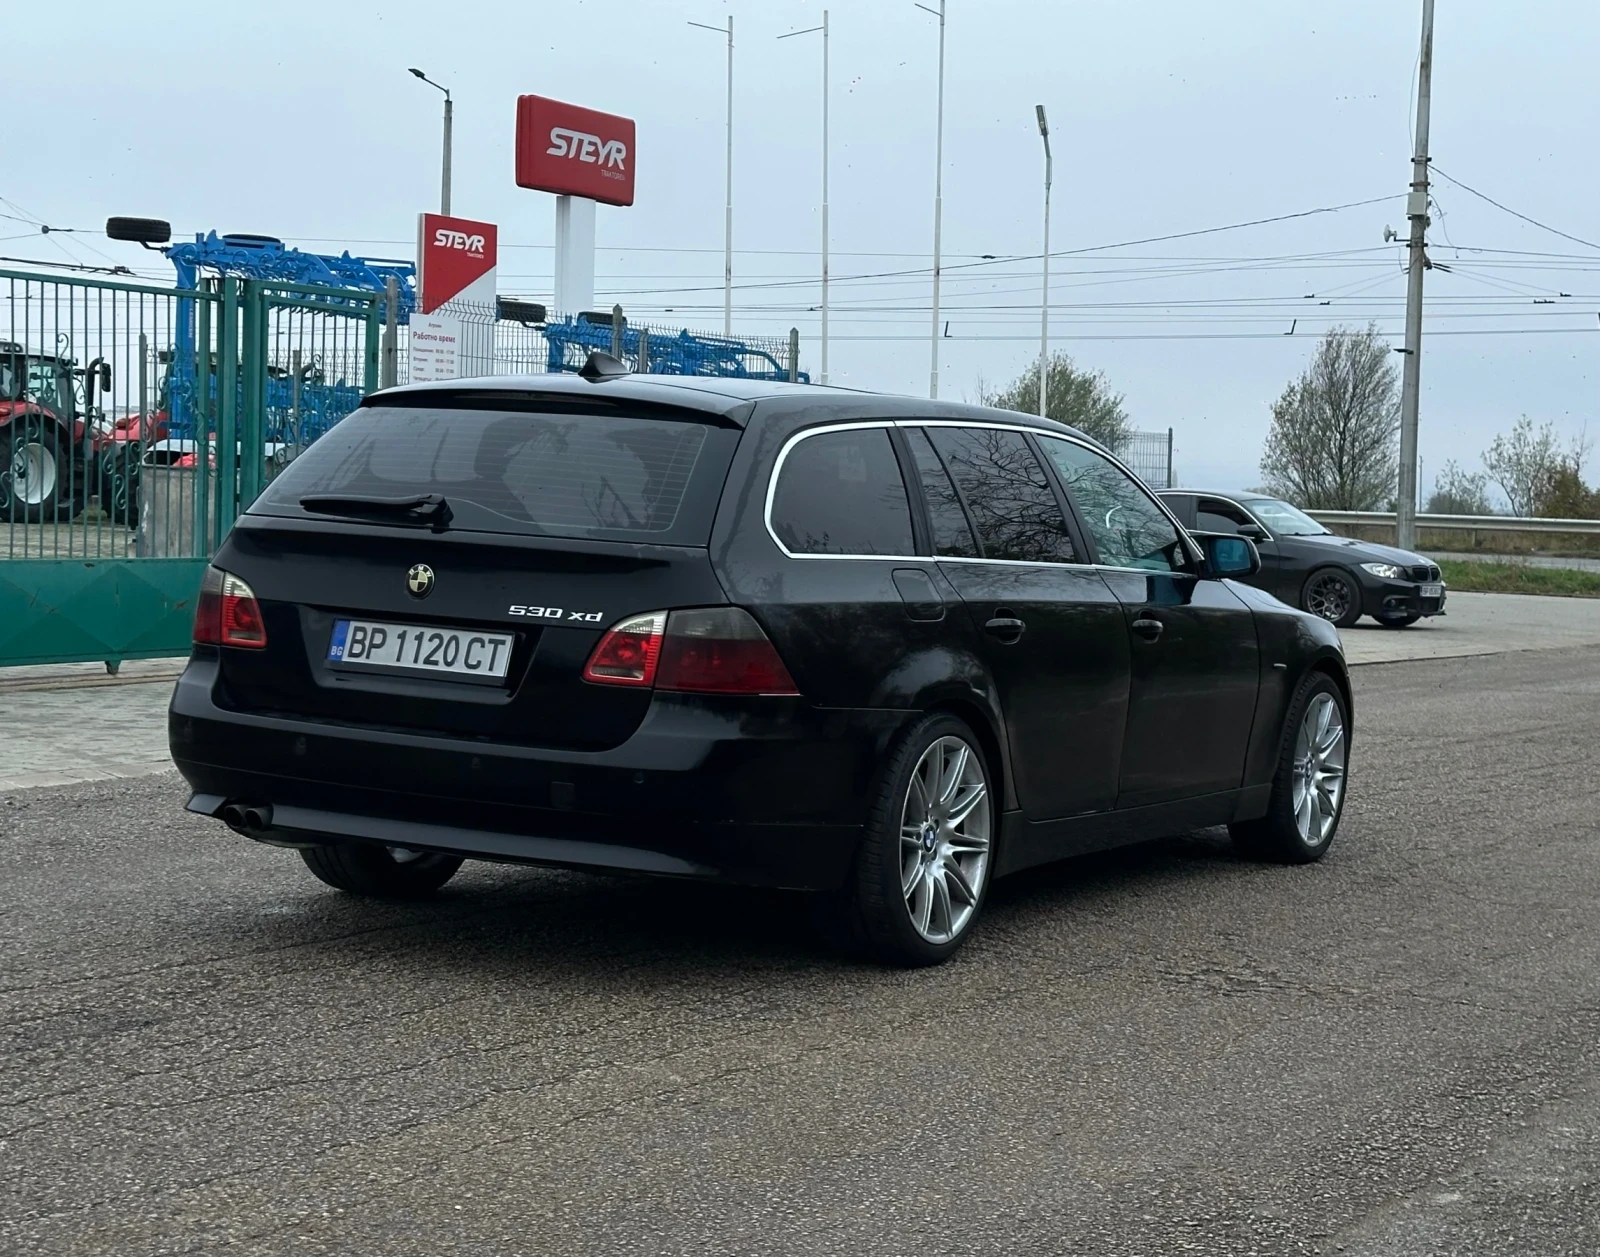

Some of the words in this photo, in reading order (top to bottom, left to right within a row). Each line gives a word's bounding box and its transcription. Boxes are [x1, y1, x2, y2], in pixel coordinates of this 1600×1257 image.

[546, 126, 627, 170] STEYR
[433, 229, 485, 253] STEYR
[412, 331, 437, 341] Работно
[438, 335, 456, 343] време
[508, 604, 562, 620] 530
[567, 611, 603, 623] xd
[331, 645, 343, 656] BG
